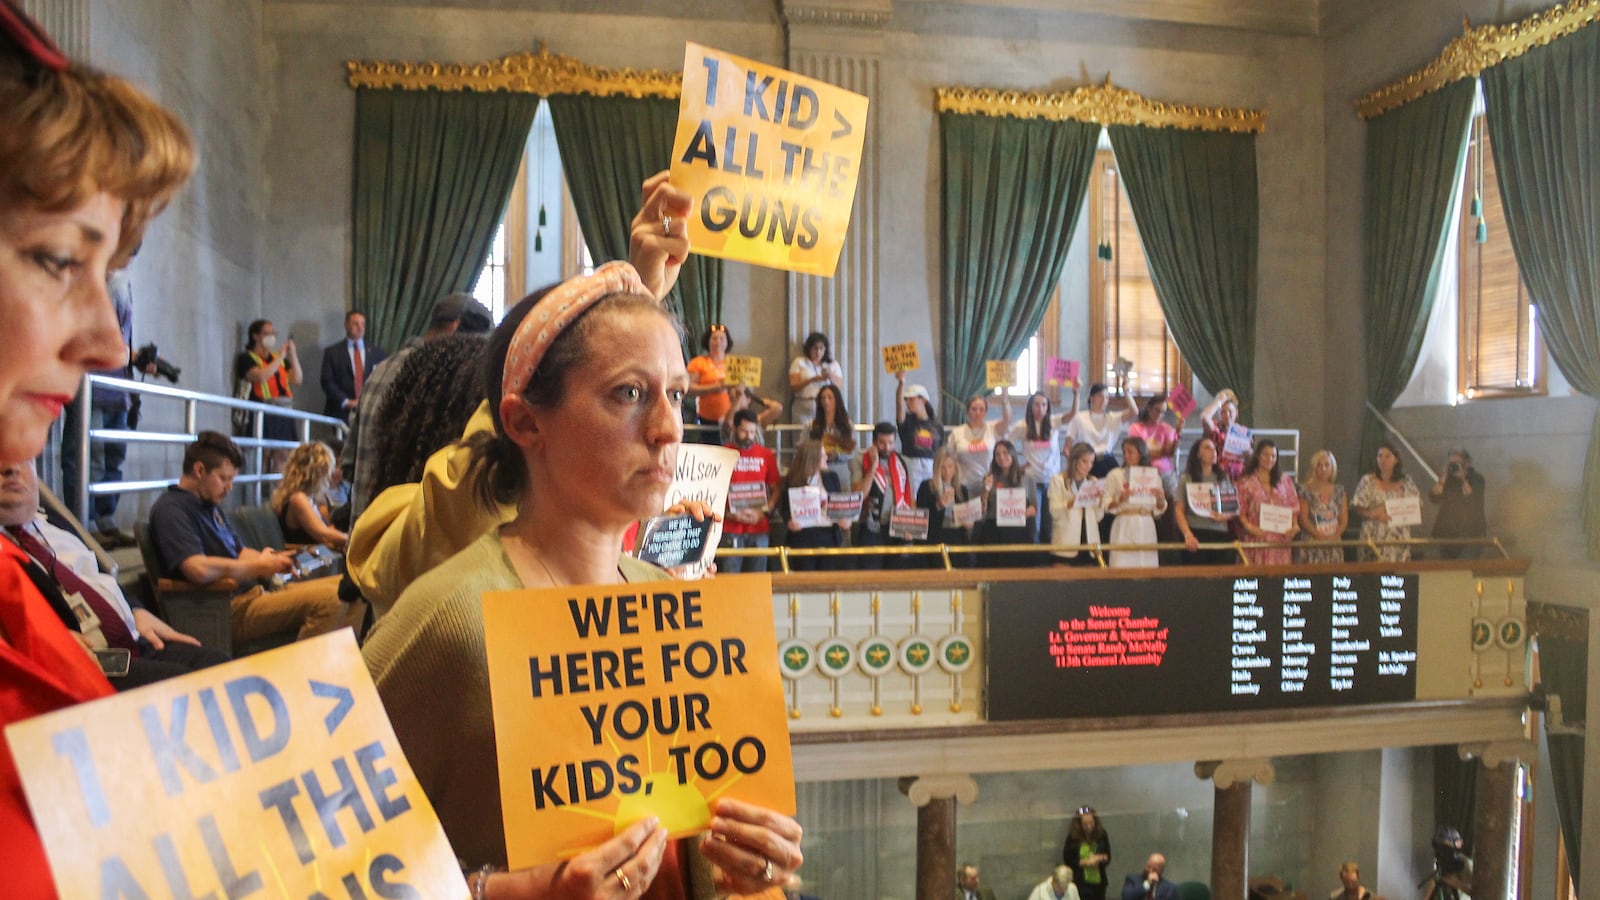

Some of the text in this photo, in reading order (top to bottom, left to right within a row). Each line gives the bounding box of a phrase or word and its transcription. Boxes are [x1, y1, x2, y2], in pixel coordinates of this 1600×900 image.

[703, 57, 719, 108] 1
[743, 70, 820, 130] KID
[681, 119, 851, 199] ALL THE
[700, 186, 822, 249] GUNS
[568, 590, 703, 638] WE'RE
[1060, 616, 1160, 631] to the Senate Chamber
[1089, 605, 1131, 618] Welcome
[1233, 605, 1264, 618] Bowling
[1283, 604, 1301, 616] Kyle
[1049, 640, 1168, 656] the Senate Randy McNally
[1064, 631, 1108, 642] Governor
[1109, 630, 1119, 642] &
[1120, 629, 1157, 643] Speaker
[1157, 627, 1169, 640] of
[1232, 631, 1266, 643] Campbell
[529, 638, 748, 698] HERE FOR
[1056, 652, 1162, 667] 113th General Assembly
[580, 693, 711, 745] YOUR
[50, 725, 113, 829] 1
[139, 674, 292, 797] KID
[532, 736, 767, 810] KIDS, TOO
[259, 740, 412, 866] THE
